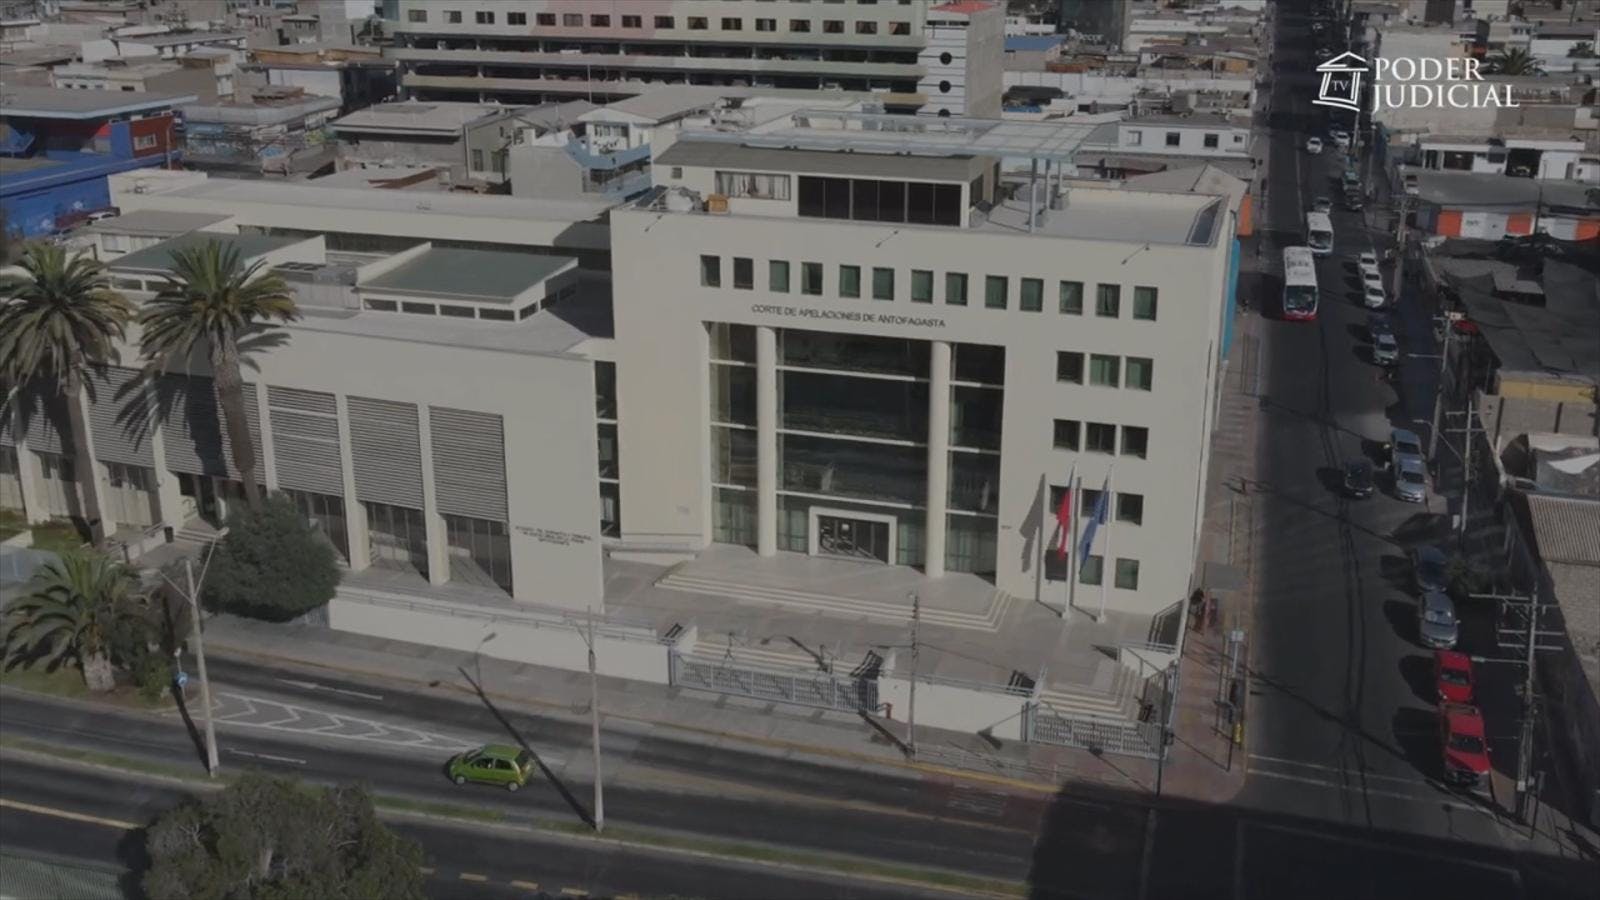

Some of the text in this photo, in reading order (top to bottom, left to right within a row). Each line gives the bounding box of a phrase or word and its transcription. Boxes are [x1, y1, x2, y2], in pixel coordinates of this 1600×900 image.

[752, 304, 946, 327] CORTE DE APELACIONES DE ANTOFAGASTA
